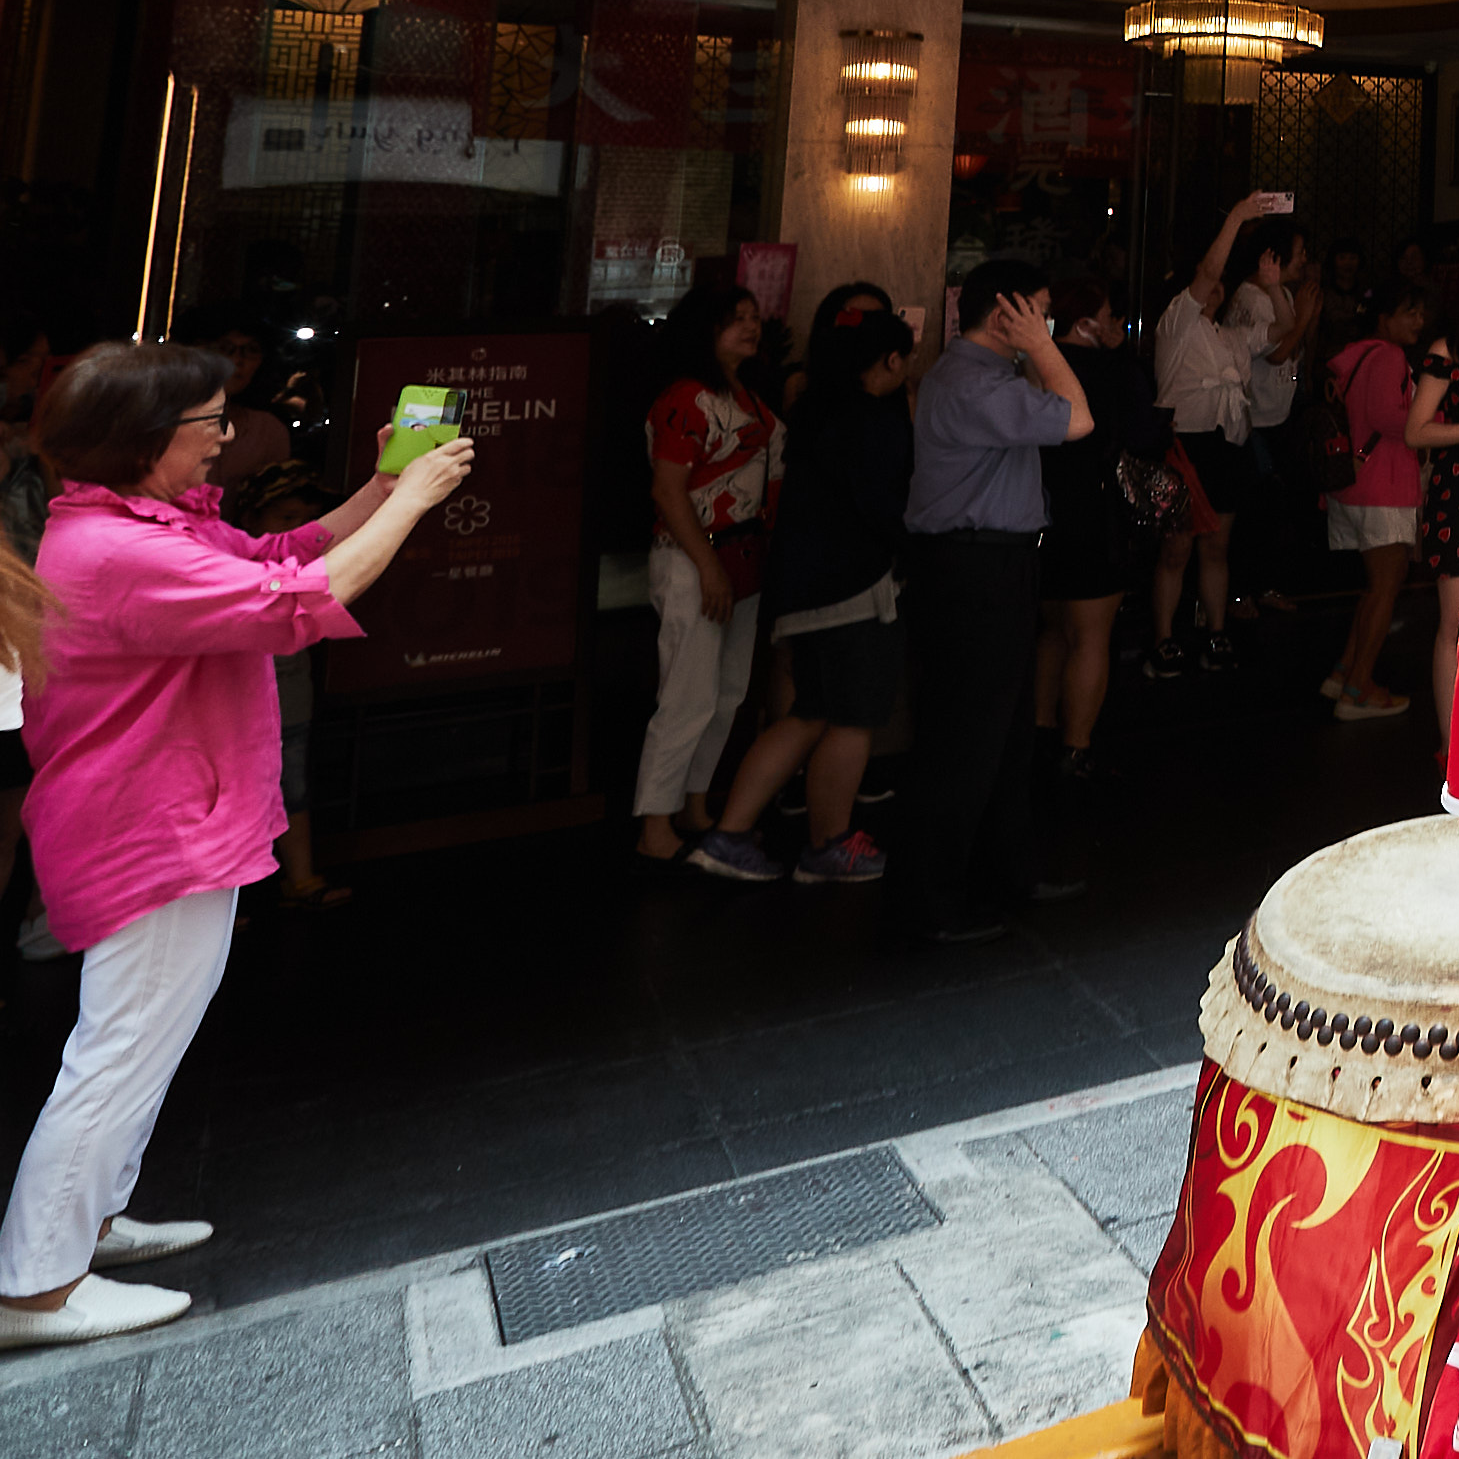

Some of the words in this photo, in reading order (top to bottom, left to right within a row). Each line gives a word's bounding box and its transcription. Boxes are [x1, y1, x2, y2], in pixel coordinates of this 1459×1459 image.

[427, 364, 528, 383] 米其林指南
